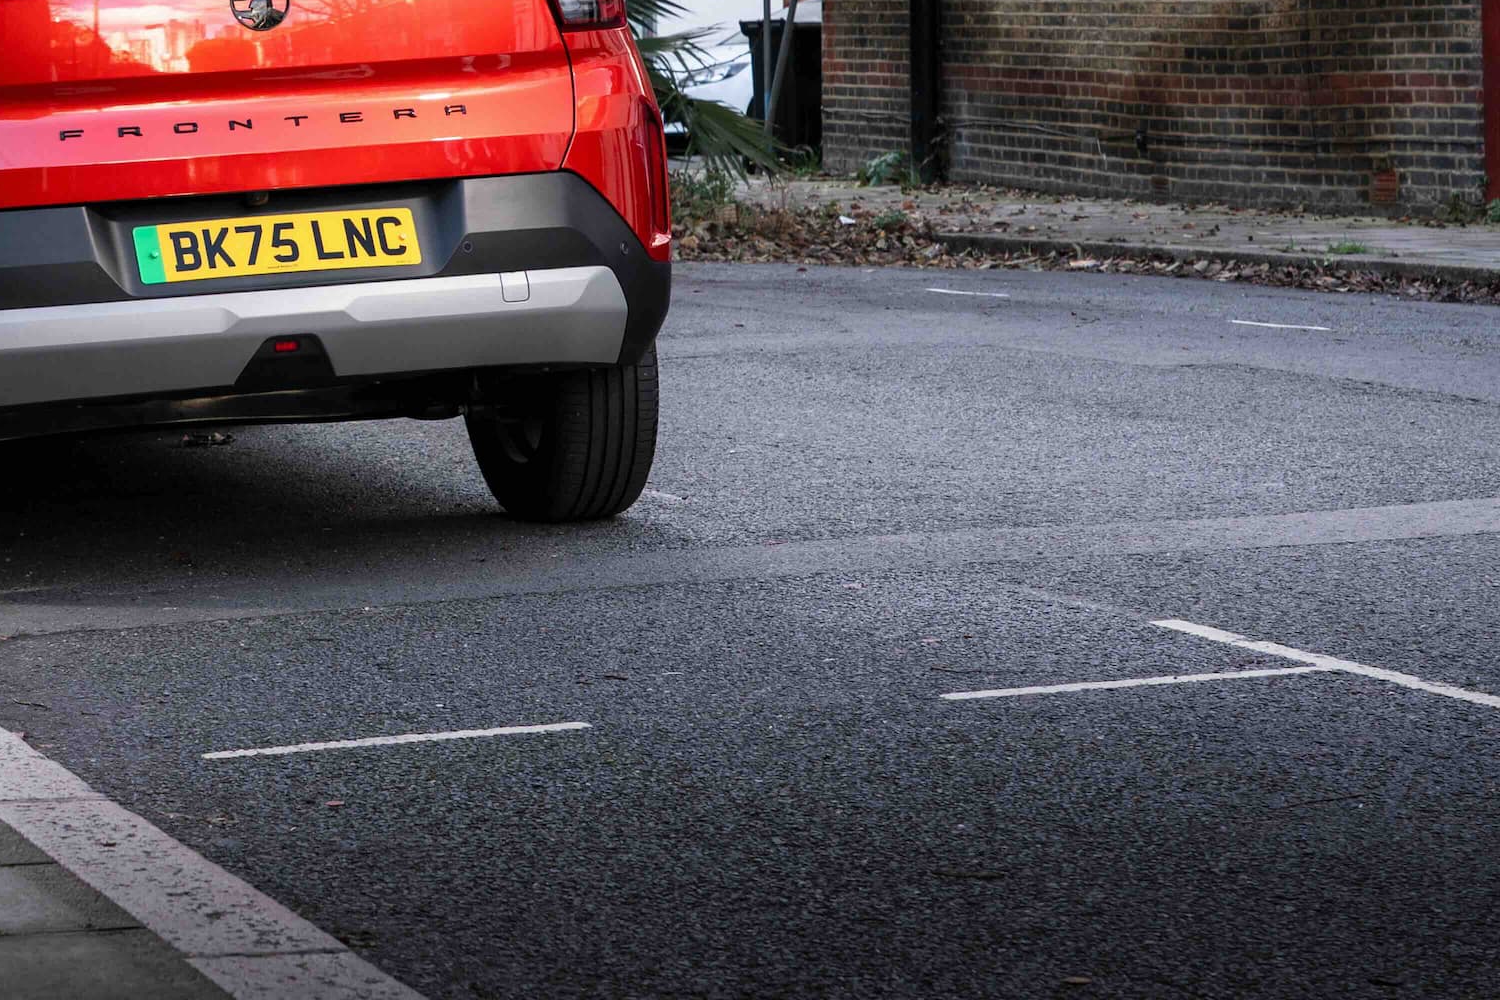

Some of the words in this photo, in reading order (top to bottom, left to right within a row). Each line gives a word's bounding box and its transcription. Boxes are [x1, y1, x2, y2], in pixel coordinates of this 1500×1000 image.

[60, 104, 467, 142] FRONTERA
[169, 222, 300, 273] BK75
[311, 216, 408, 260] LNC
